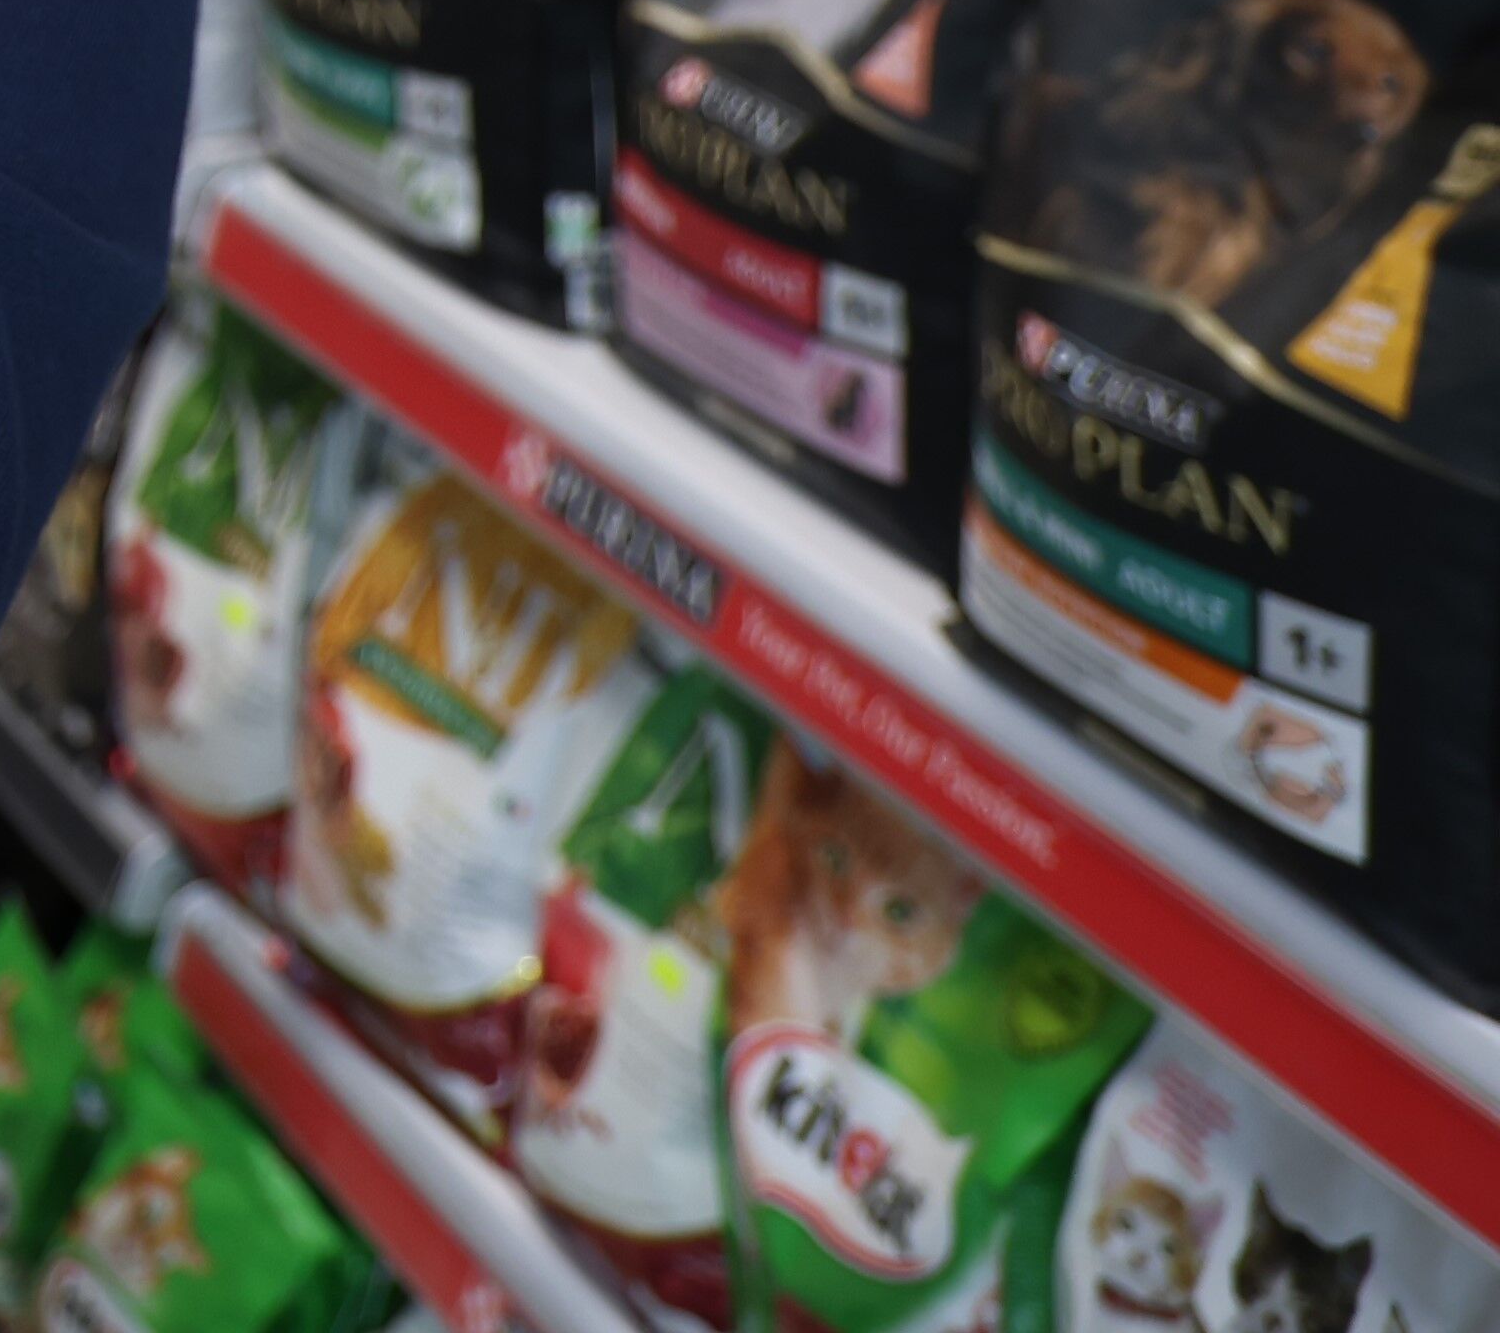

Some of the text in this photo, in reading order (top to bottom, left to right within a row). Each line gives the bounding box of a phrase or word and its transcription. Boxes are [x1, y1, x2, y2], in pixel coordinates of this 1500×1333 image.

[1046, 337, 1204, 445] PURINA
[542, 459, 716, 625] PURINA
[1071, 415, 1296, 557] PLAN
[1286, 625, 1338, 673] 1+
